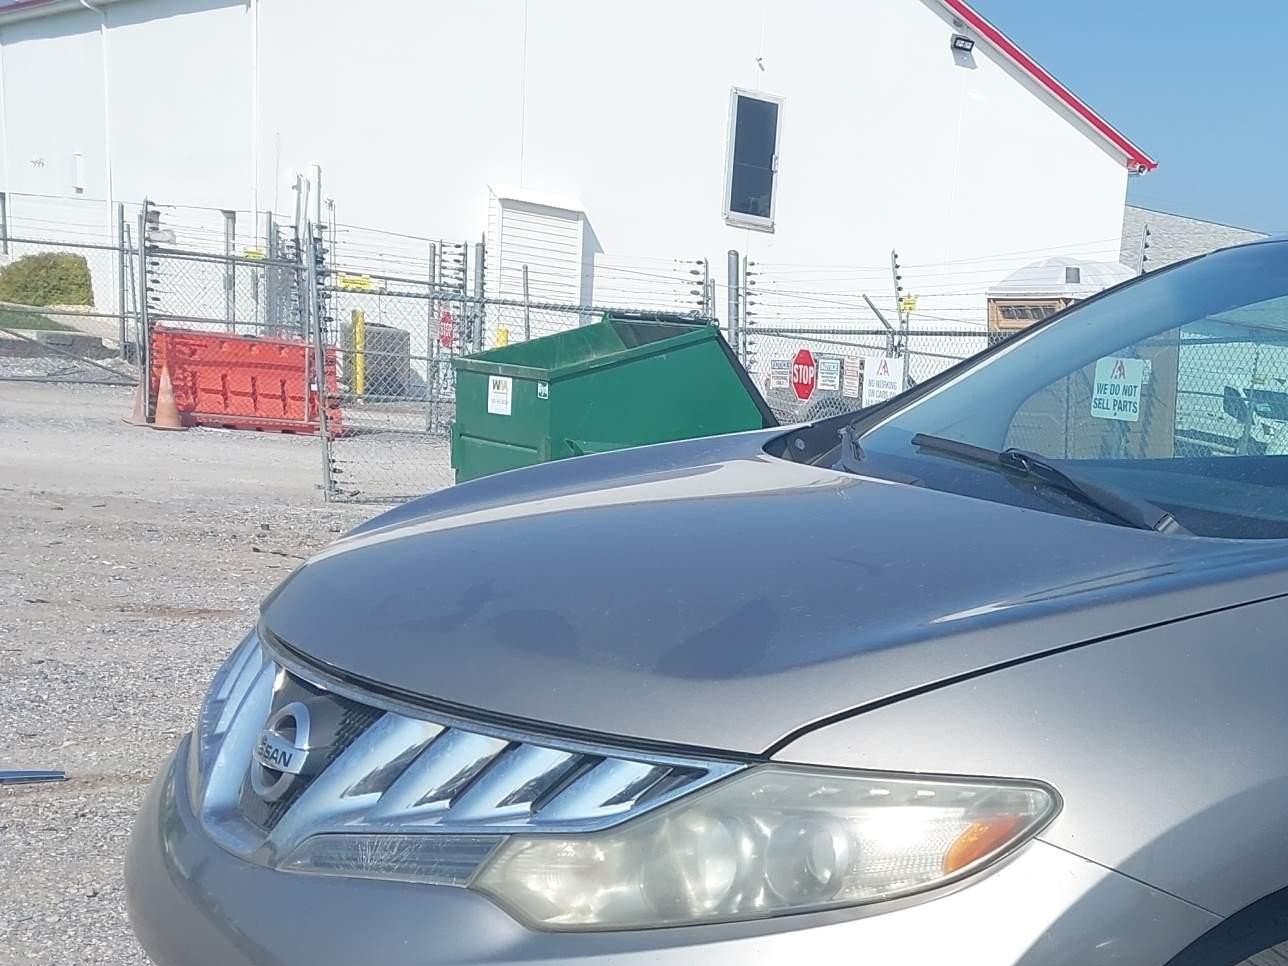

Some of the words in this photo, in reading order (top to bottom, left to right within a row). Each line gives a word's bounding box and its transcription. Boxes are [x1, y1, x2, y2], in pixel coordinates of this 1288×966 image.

[793, 364, 814, 385] STOP
[868, 379, 875, 387] NO
[876, 380, 897, 390] WORKING
[1096, 383, 1109, 395] WE
[1110, 384, 1120, 396] DO
[1122, 385, 1138, 397] NOT
[868, 389, 875, 397] ON
[1093, 398, 1110, 410] SELL
[1113, 399, 1137, 413] PARTS
[257, 735, 293, 768] SSAN
